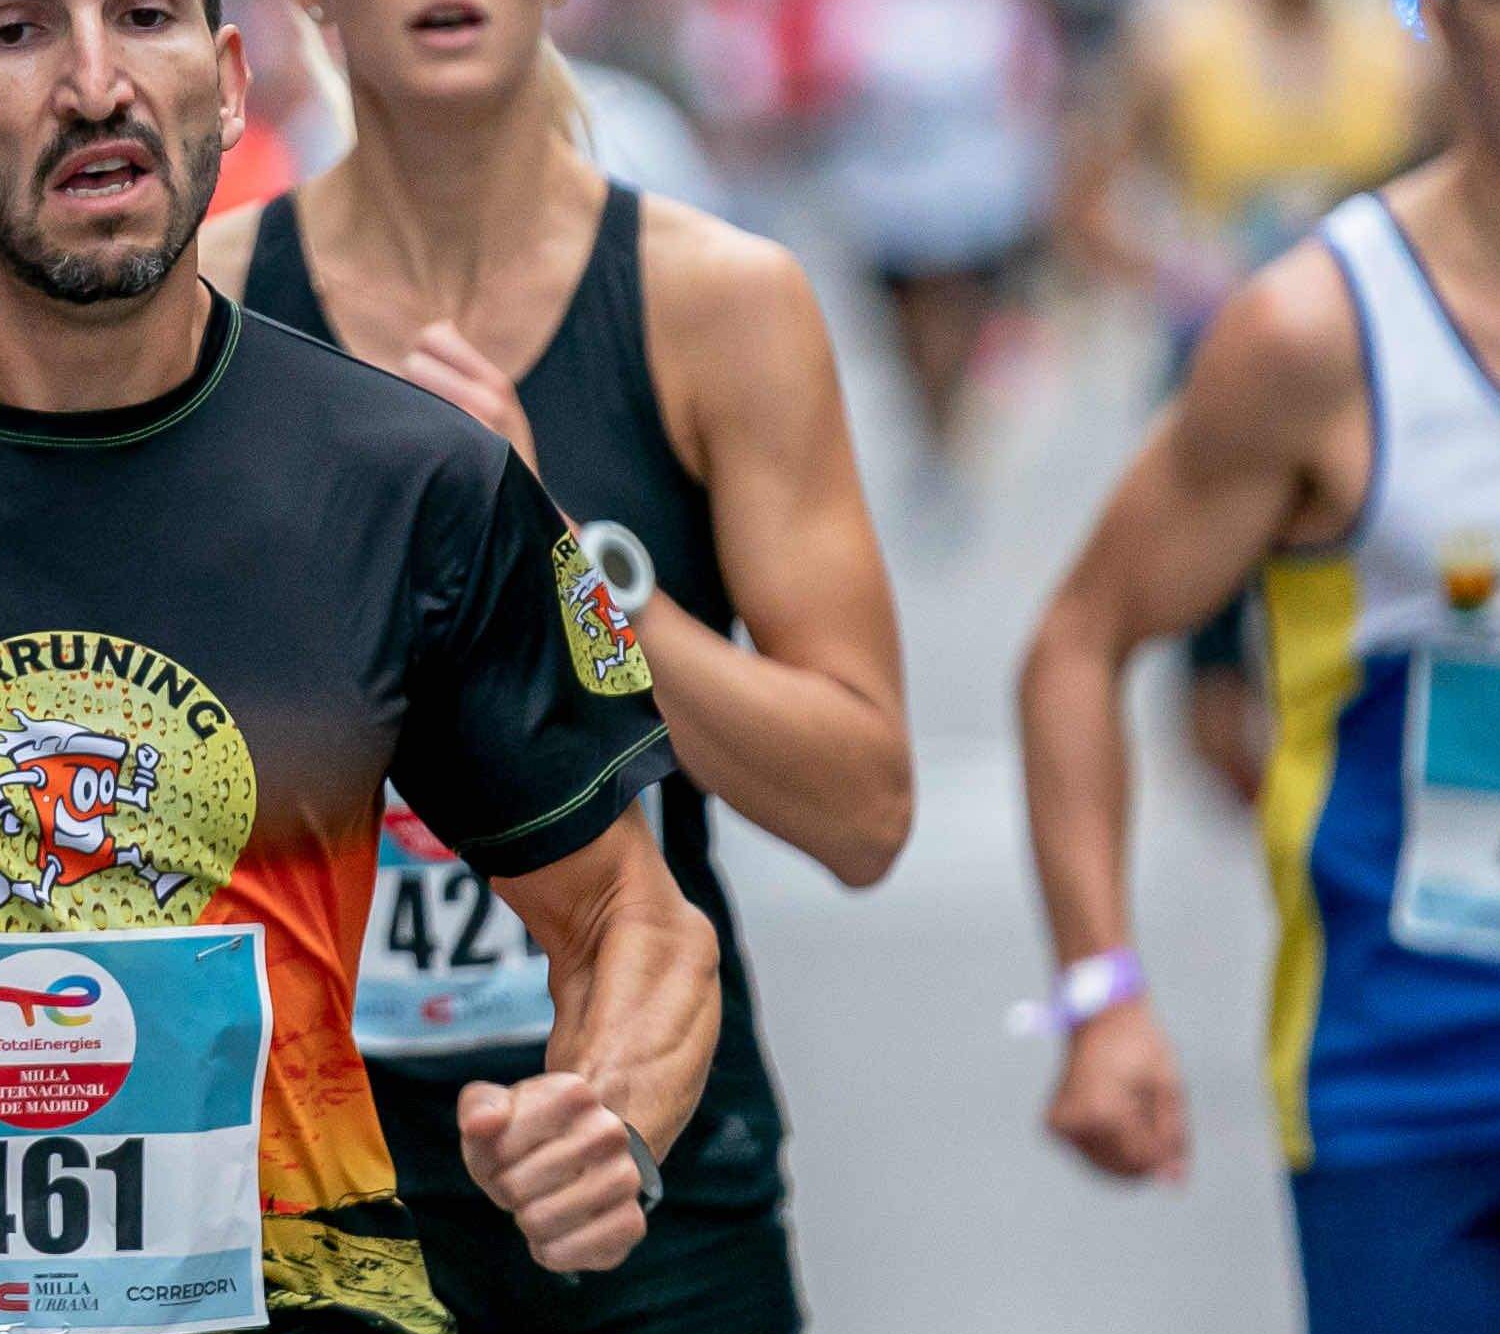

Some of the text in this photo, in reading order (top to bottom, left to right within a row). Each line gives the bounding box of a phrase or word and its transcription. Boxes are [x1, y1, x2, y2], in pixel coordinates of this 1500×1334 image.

[388, 872, 547, 971] 42
[20, 1069, 70, 1083] MILLA
[0, 1099, 89, 1115] DE MADRID
[34, 1280, 91, 1295] MILLA
[34, 1298, 99, 1312] URBANA
